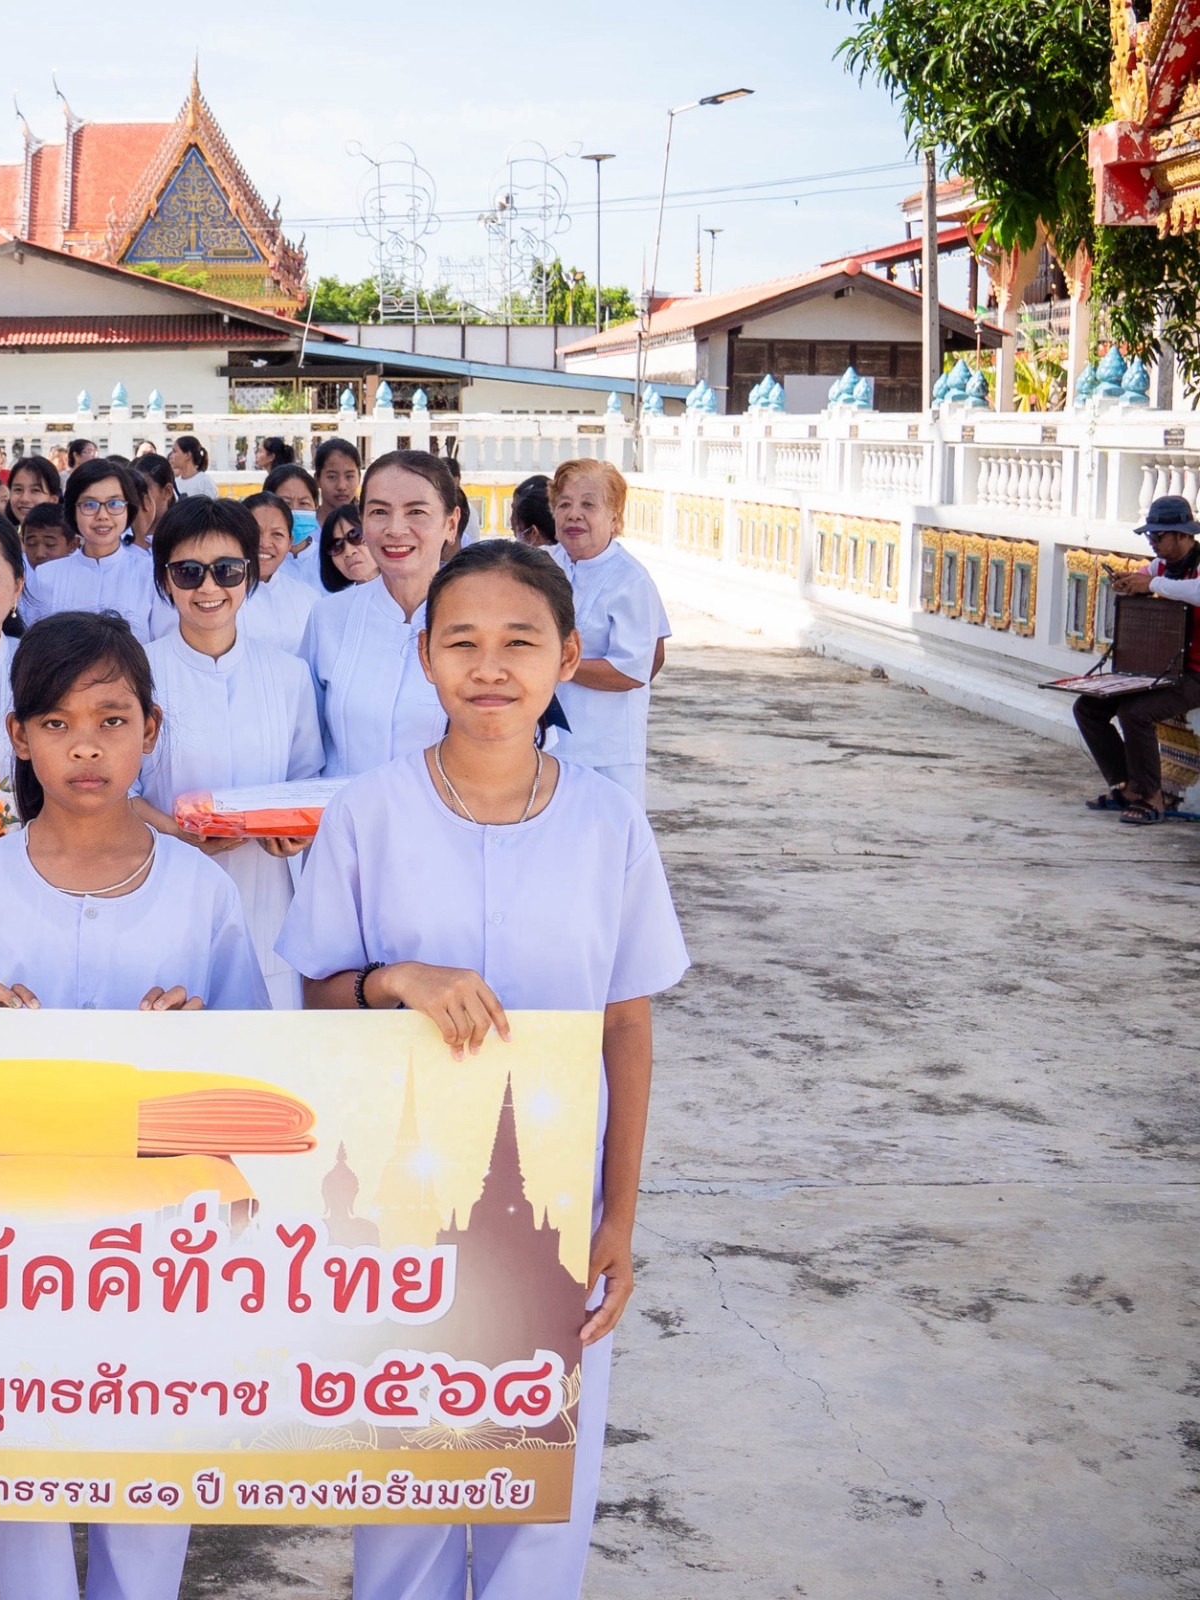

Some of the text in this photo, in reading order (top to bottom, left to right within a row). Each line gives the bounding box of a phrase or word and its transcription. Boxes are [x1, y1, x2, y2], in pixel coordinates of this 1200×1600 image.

[296, 1360, 553, 1417] ๒๕๖๘
[128, 1483, 180, 1506] ๘๑
[197, 1471, 221, 1505] ปี
[238, 1471, 531, 1506] หลวงพ่อธัมมชโย
